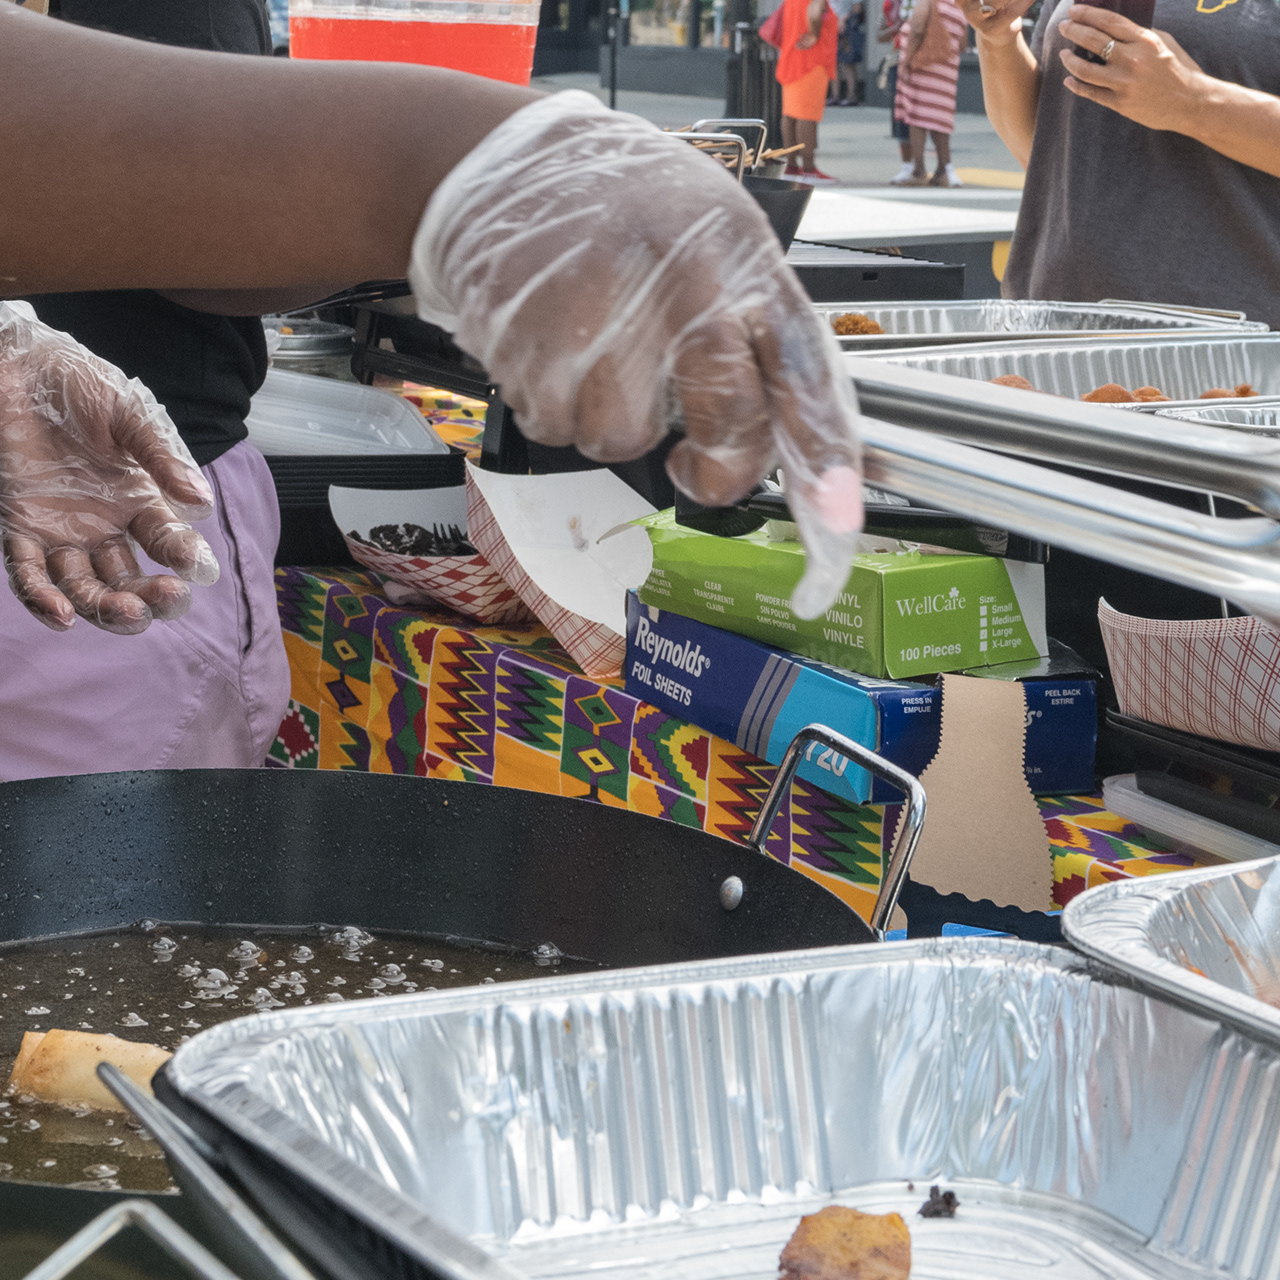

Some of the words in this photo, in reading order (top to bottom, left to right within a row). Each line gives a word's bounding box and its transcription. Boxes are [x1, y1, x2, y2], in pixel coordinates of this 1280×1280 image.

[703, 580, 722, 592] CLEAR
[693, 587, 735, 606] TRANSPARENTE
[755, 592, 780, 606] POWDER
[781, 598, 794, 609] FRE
[835, 592, 862, 609] INYL
[979, 596, 997, 605] Size:
[896, 594, 967, 617] WellCare
[991, 603, 1013, 614] Small
[770, 607, 790, 620] POLVO
[825, 609, 863, 629] VINILO
[991, 614, 1022, 626] Medium
[823, 627, 865, 649] VINYLE
[991, 626, 1013, 638] Large
[991, 637, 1022, 650] X-Large
[900, 647, 920, 662] 100
[923, 643, 962, 660] Pieces
[631, 661, 653, 687] FOIL
[653, 674, 693, 706] SHEETS
[1044, 689, 1062, 698] PEEL
[1063, 688, 1081, 697] BACK
[901, 696, 923, 706] PRESS
[924, 696, 933, 705] IN
[1051, 697, 1075, 706] ESTIRE
[903, 705, 932, 715] EMPUJE
